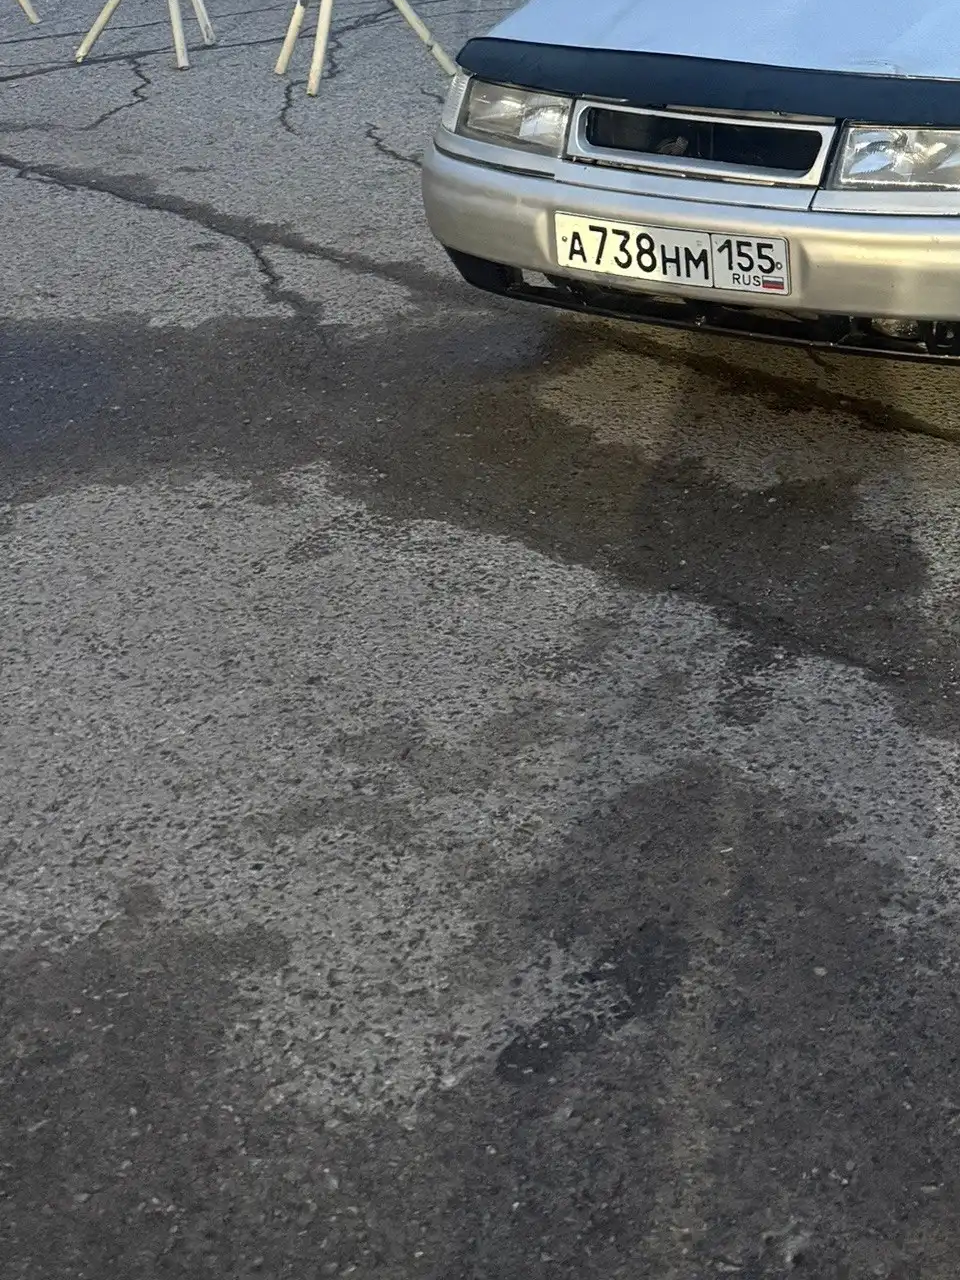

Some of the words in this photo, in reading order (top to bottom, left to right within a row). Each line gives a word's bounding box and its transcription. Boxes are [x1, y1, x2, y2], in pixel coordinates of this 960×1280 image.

[568, 225, 710, 280] А738НМ
[716, 239, 775, 274] 155
[732, 274, 761, 287] RUS
